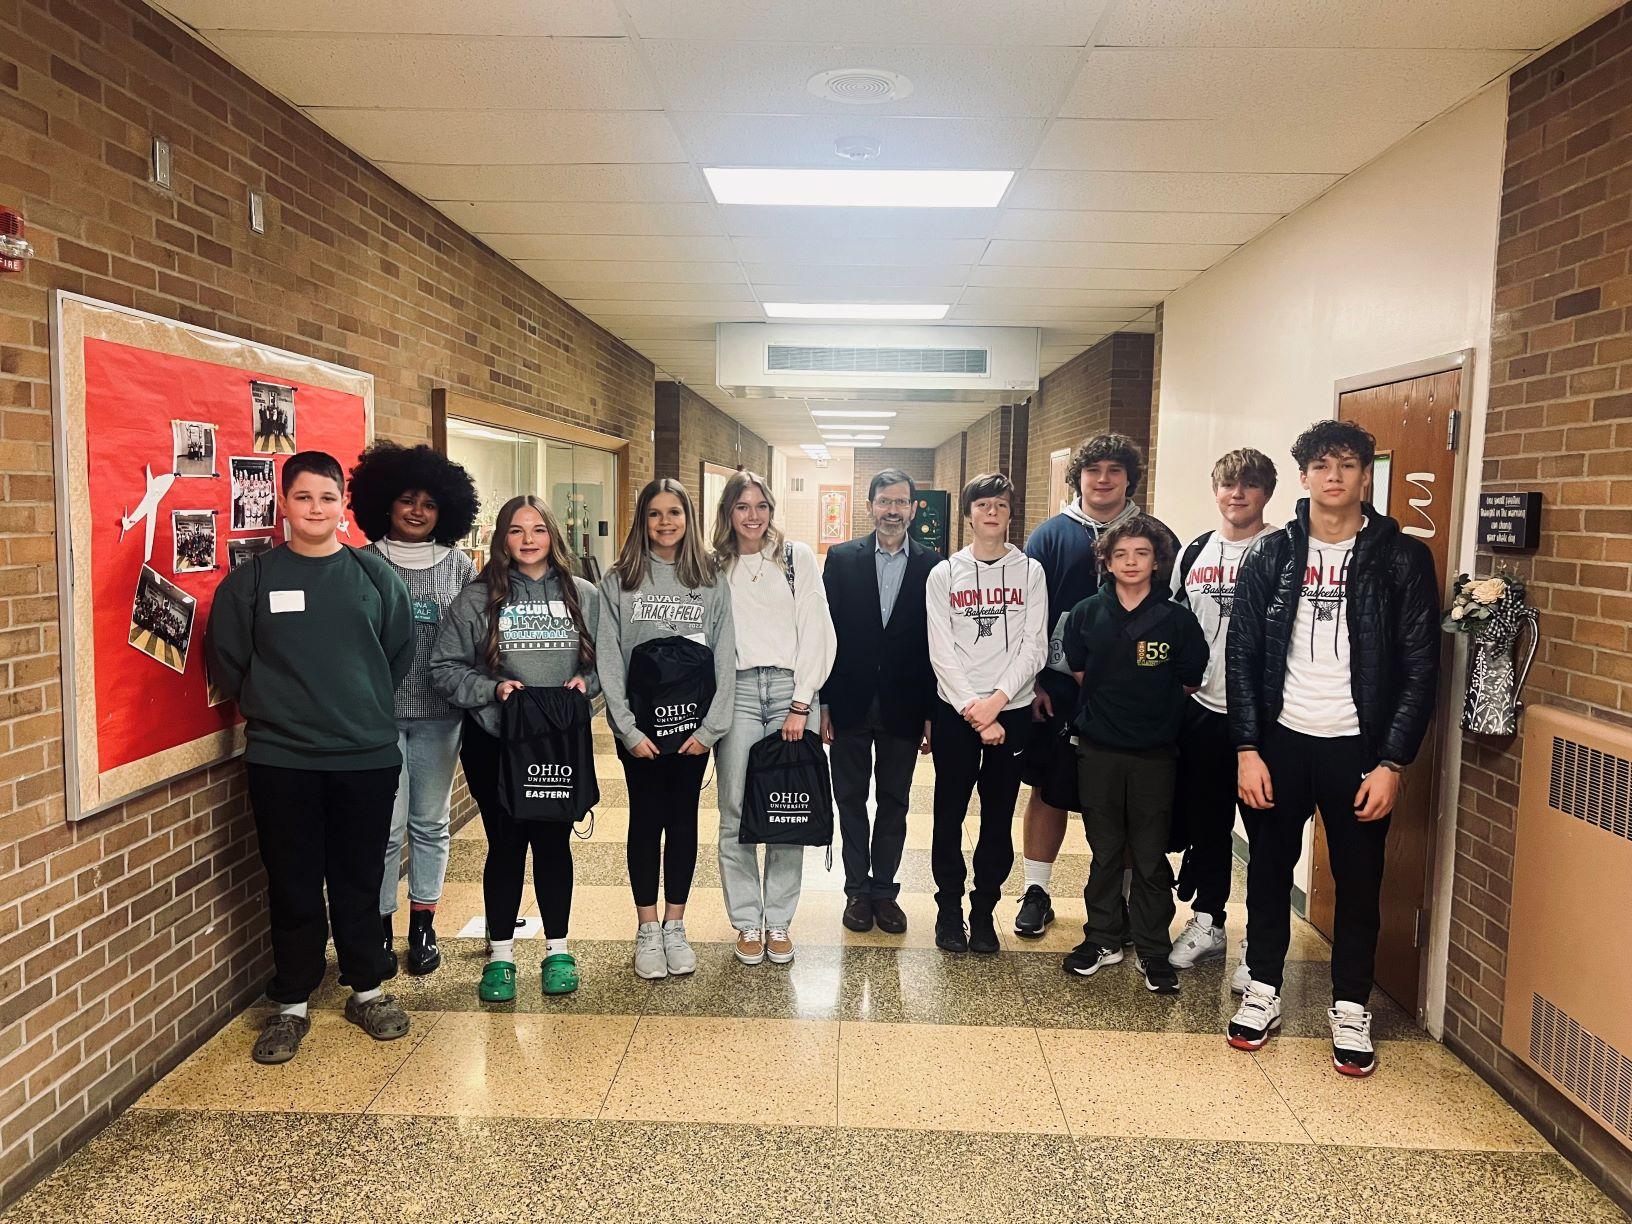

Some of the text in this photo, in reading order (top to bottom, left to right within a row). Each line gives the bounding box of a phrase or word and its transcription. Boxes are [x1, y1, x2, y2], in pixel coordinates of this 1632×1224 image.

[0, 258, 19, 270] IRE
[647, 595, 681, 603] OVAC
[950, 587, 1025, 608] NION LOCAL
[641, 603, 671, 620] TRACK
[674, 605, 702, 622] FIELD
[503, 630, 568, 640] VOLLEYBALL
[1145, 641, 1170, 660] 59
[654, 702, 698, 718] OHIO
[656, 722, 698, 737] EASTERN
[527, 764, 573, 777] OHIO
[525, 790, 570, 799] EASTERN
[769, 791, 810, 804] OHIO
[769, 815, 809, 823] EASTERN
